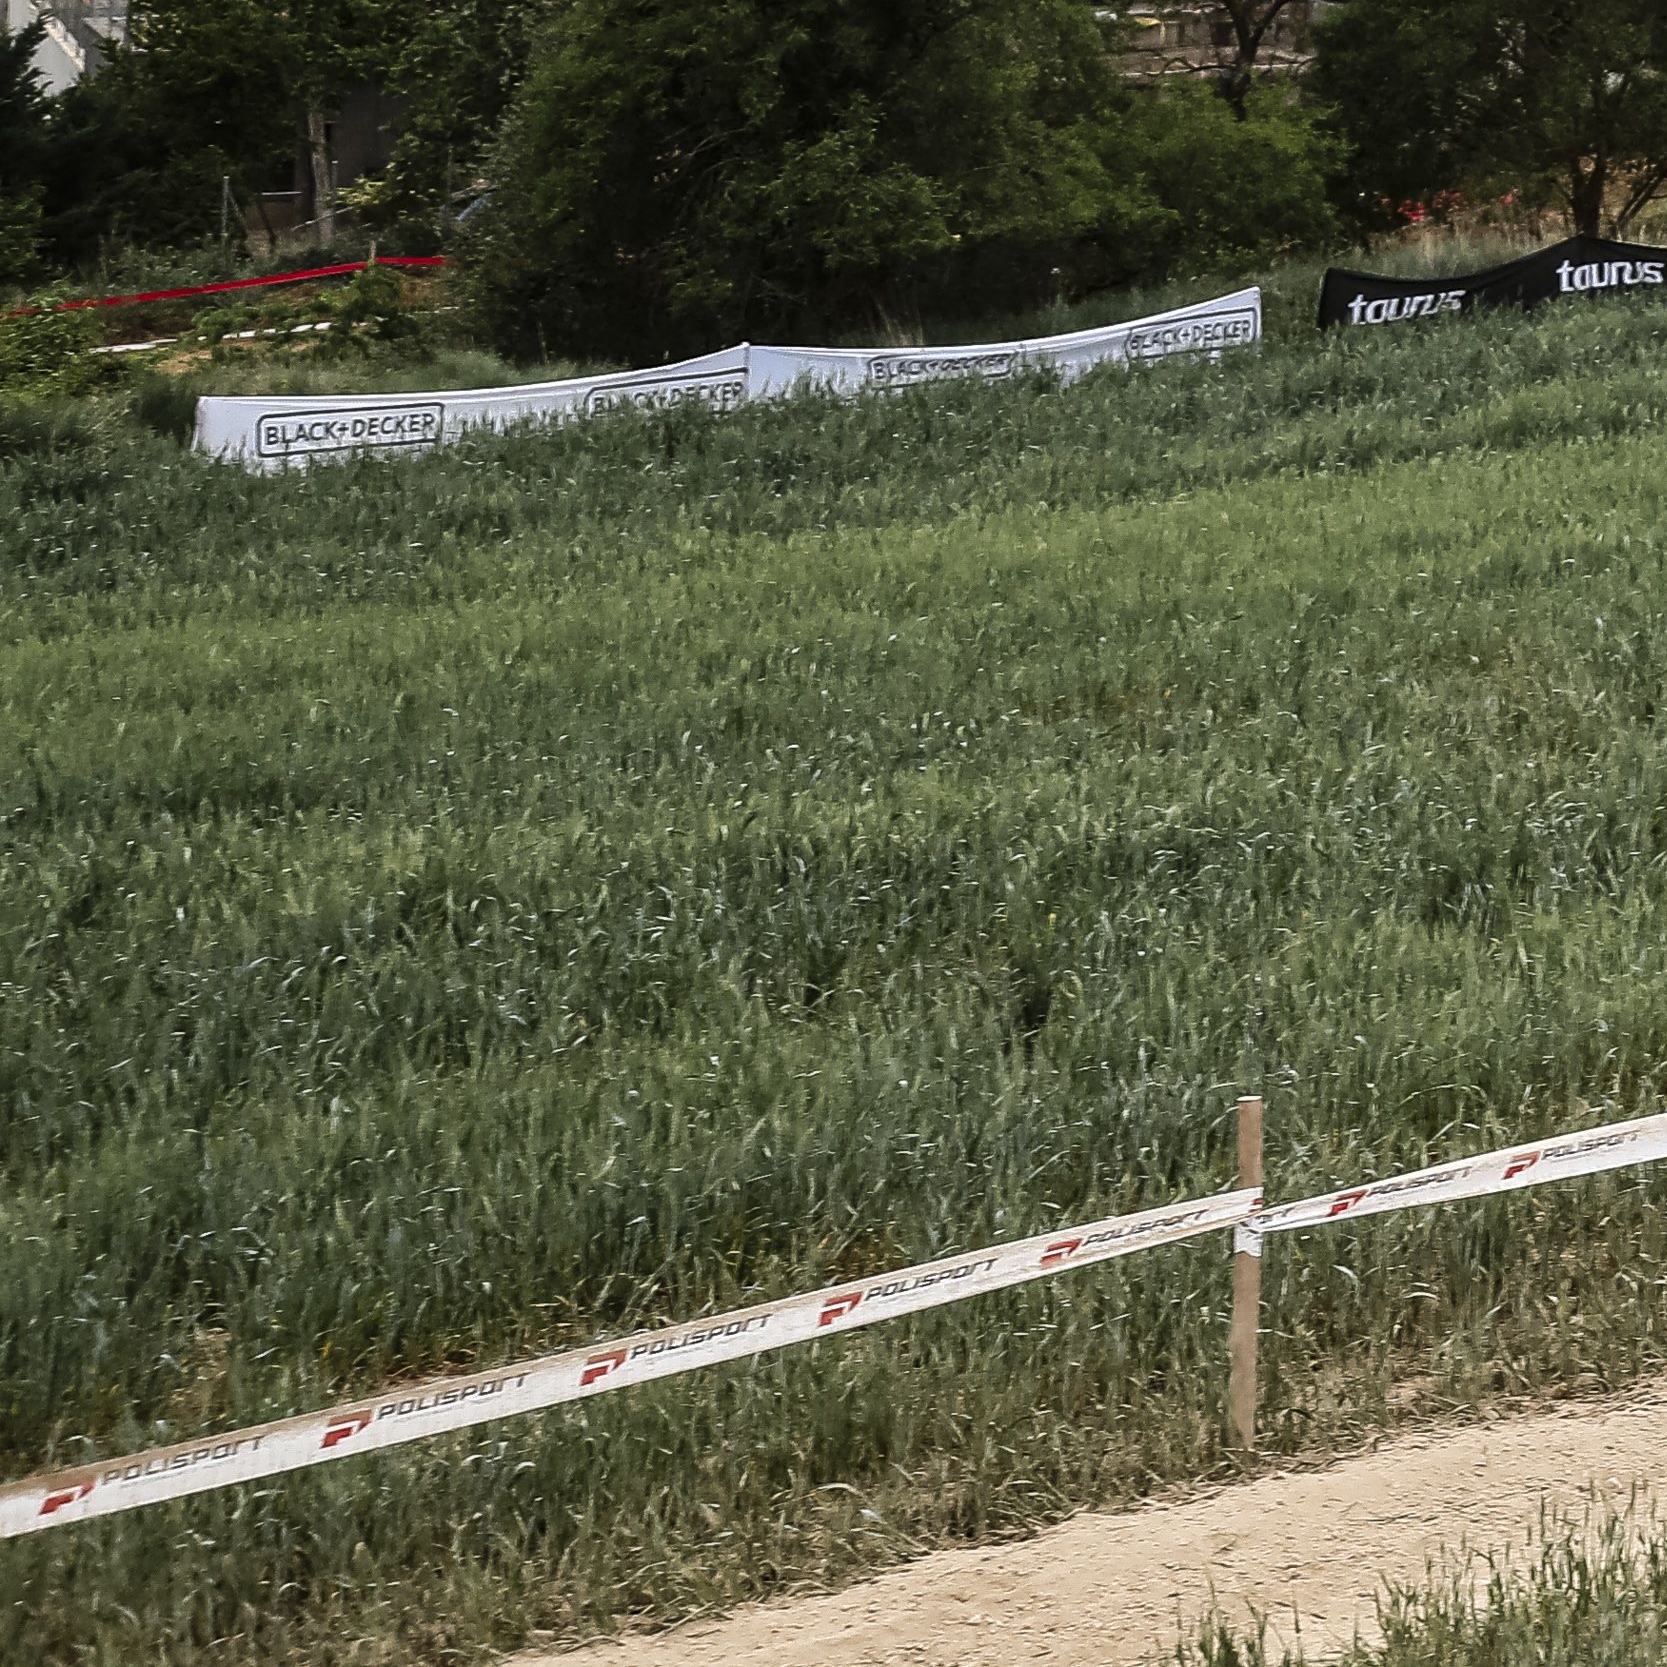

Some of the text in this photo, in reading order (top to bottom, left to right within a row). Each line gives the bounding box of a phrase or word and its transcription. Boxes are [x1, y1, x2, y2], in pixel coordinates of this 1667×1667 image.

[1555, 259, 1665, 292] taurus
[1348, 289, 1467, 326] taurus
[265, 413, 436, 446] BLACK+DECKER
[102, 1434, 267, 1486] POLISPORT
[376, 1371, 532, 1421] POLISPORT
[628, 1312, 774, 1360] POLISPORT
[863, 1257, 999, 1302] POLISPORT
